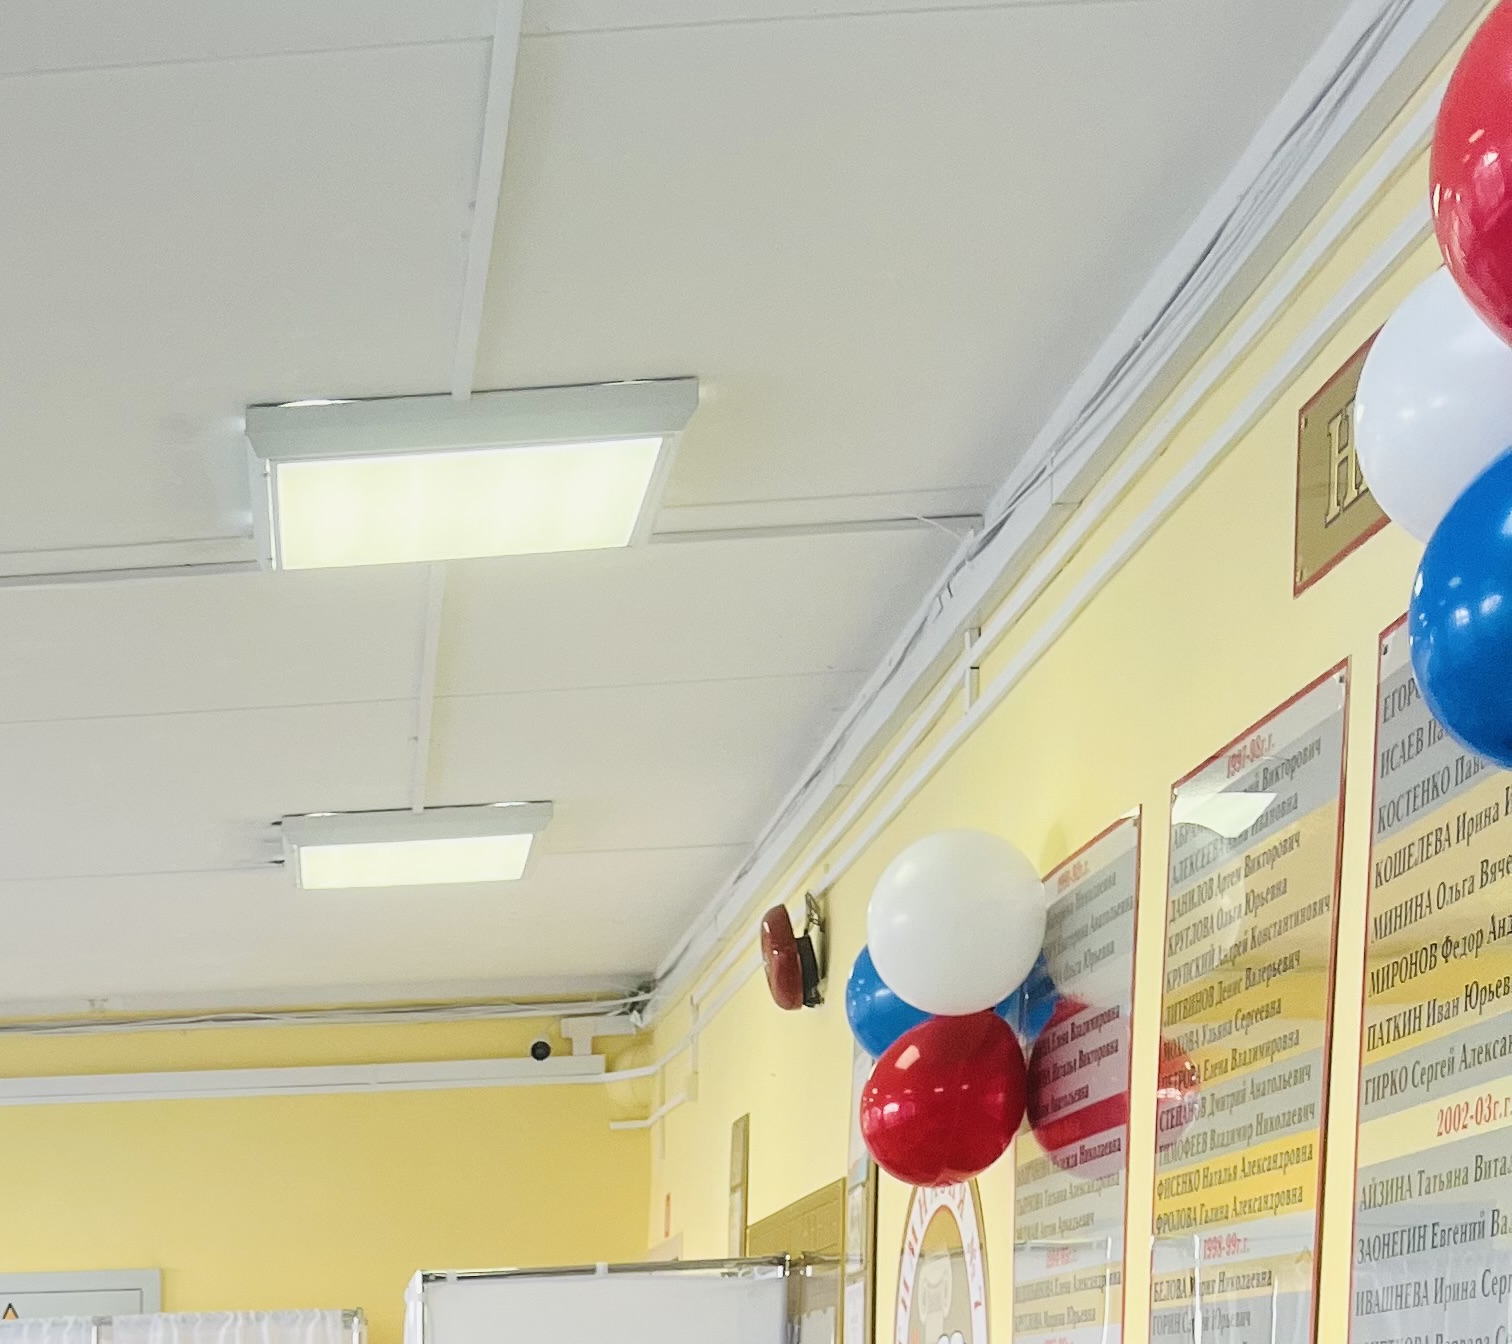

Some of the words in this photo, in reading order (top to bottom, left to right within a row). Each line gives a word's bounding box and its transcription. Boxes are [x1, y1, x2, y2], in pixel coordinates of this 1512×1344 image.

[1382, 677, 1422, 724] ЕГОР
[1380, 727, 1424, 779] ИСАЕВ
[1427, 718, 1445, 748] Па
[1377, 766, 1451, 834] КОСТЕНКО
[1375, 822, 1452, 889] КОШЕЛЕВА
[1455, 802, 1500, 847] Ирина
[1371, 888, 1433, 944] МИНИНА
[1437, 873, 1475, 911] Ольга
[1368, 943, 1438, 998] МИРОНОВ
[1441, 928, 1483, 963] Федор
[1367, 1004, 1423, 1052] ПАТКИН
[1426, 996, 1461, 1028] Иван
[1364, 1065, 1408, 1106] ГИРКО
[1411, 1046, 1455, 1093] Сергей
[1360, 1173, 1413, 1211] АЙЗИНА
[1417, 1165, 1469, 1197] Татьяна
[1357, 1224, 1428, 1264] ЗАОНЕГИН
[1431, 1210, 1486, 1249] Евгений
[1355, 1280, 1429, 1317] ИВАШНЕВА
[1433, 1276, 1476, 1311] Ирина
